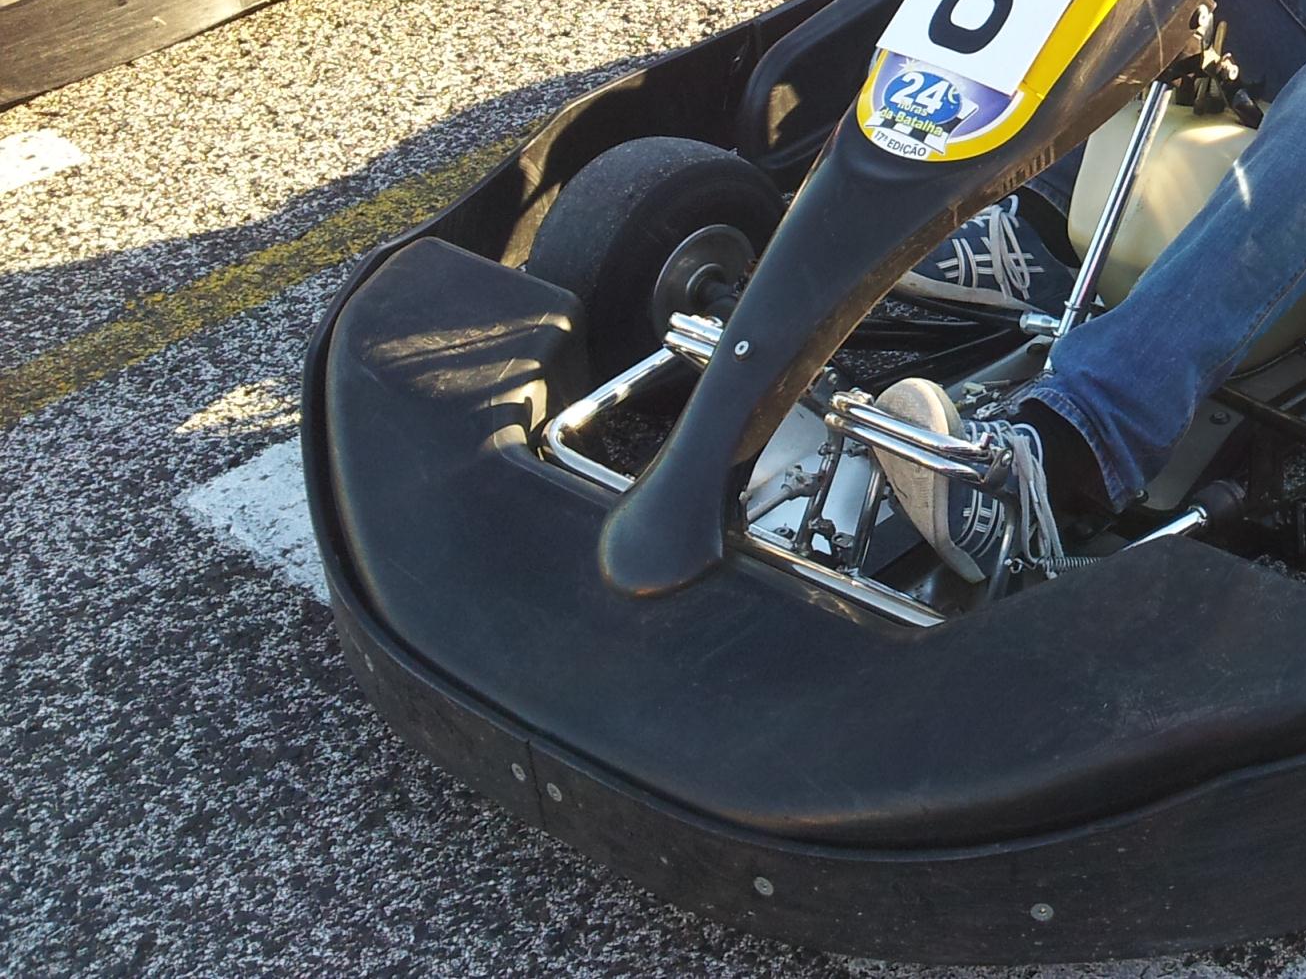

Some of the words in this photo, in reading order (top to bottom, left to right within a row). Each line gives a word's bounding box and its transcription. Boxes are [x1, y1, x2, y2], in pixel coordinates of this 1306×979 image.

[890, 71, 950, 115] 24
[896, 101, 929, 117] horas
[880, 107, 895, 120] da
[894, 111, 944, 137] Batalha
[886, 138, 928, 157] EDIÇÃO
